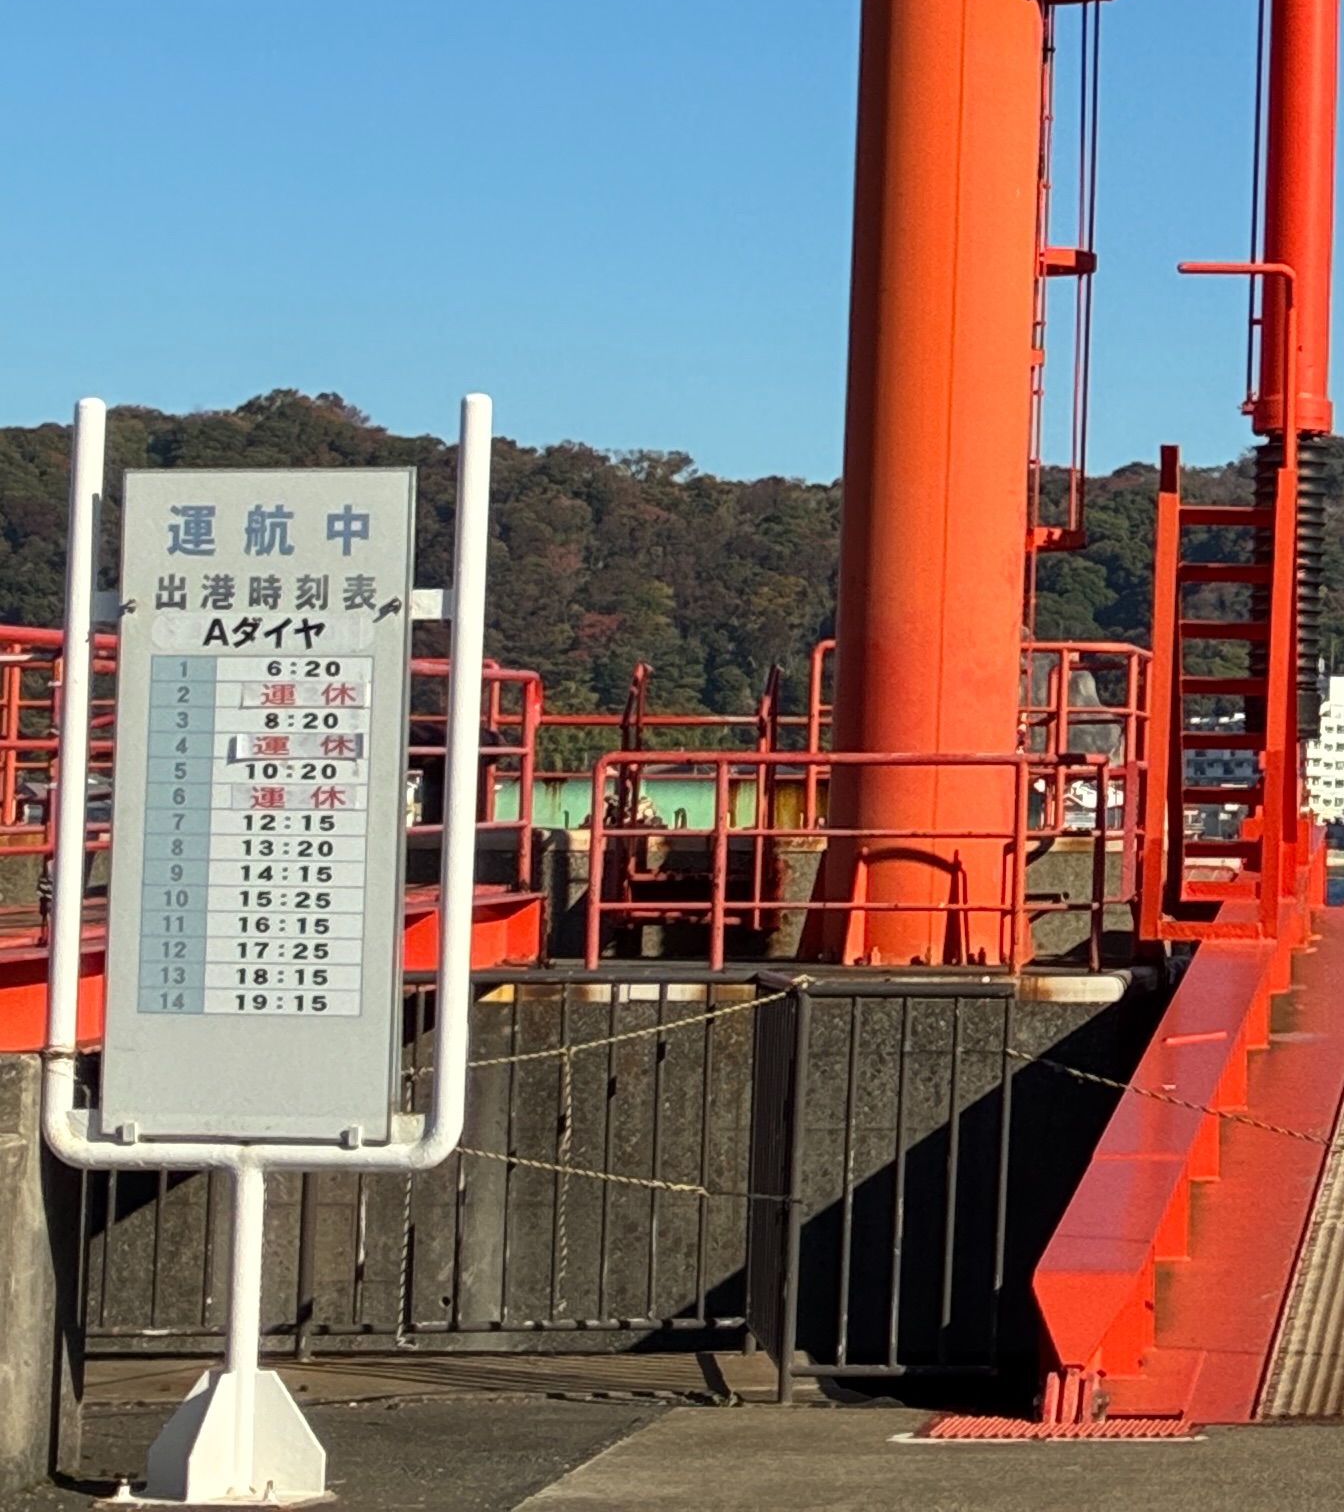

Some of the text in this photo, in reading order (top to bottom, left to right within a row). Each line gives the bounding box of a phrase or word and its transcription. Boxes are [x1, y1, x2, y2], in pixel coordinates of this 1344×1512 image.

[166, 503, 371, 557] 運航中
[154, 573, 378, 611] 出港時刻表
[202, 615, 326, 650] Aダイヤ
[179, 660, 342, 678] 1 6:20
[176, 685, 190, 703] 2
[175, 711, 339, 730] 3 8:20
[175, 736, 189, 754] 4
[174, 762, 338, 780] 5 10:20
[172, 787, 186, 806] 6
[171, 813, 336, 832] 7 12:15
[170, 838, 335, 858] 8 13:20
[169, 864, 333, 883] 9 14:15
[163, 889, 332, 909] 10 15:25
[162, 915, 331, 935] 11 16:15
[161, 941, 330, 960] 12 17:25
[160, 966, 329, 986] 13 18:15
[159, 992, 328, 1013] 14 19:15
